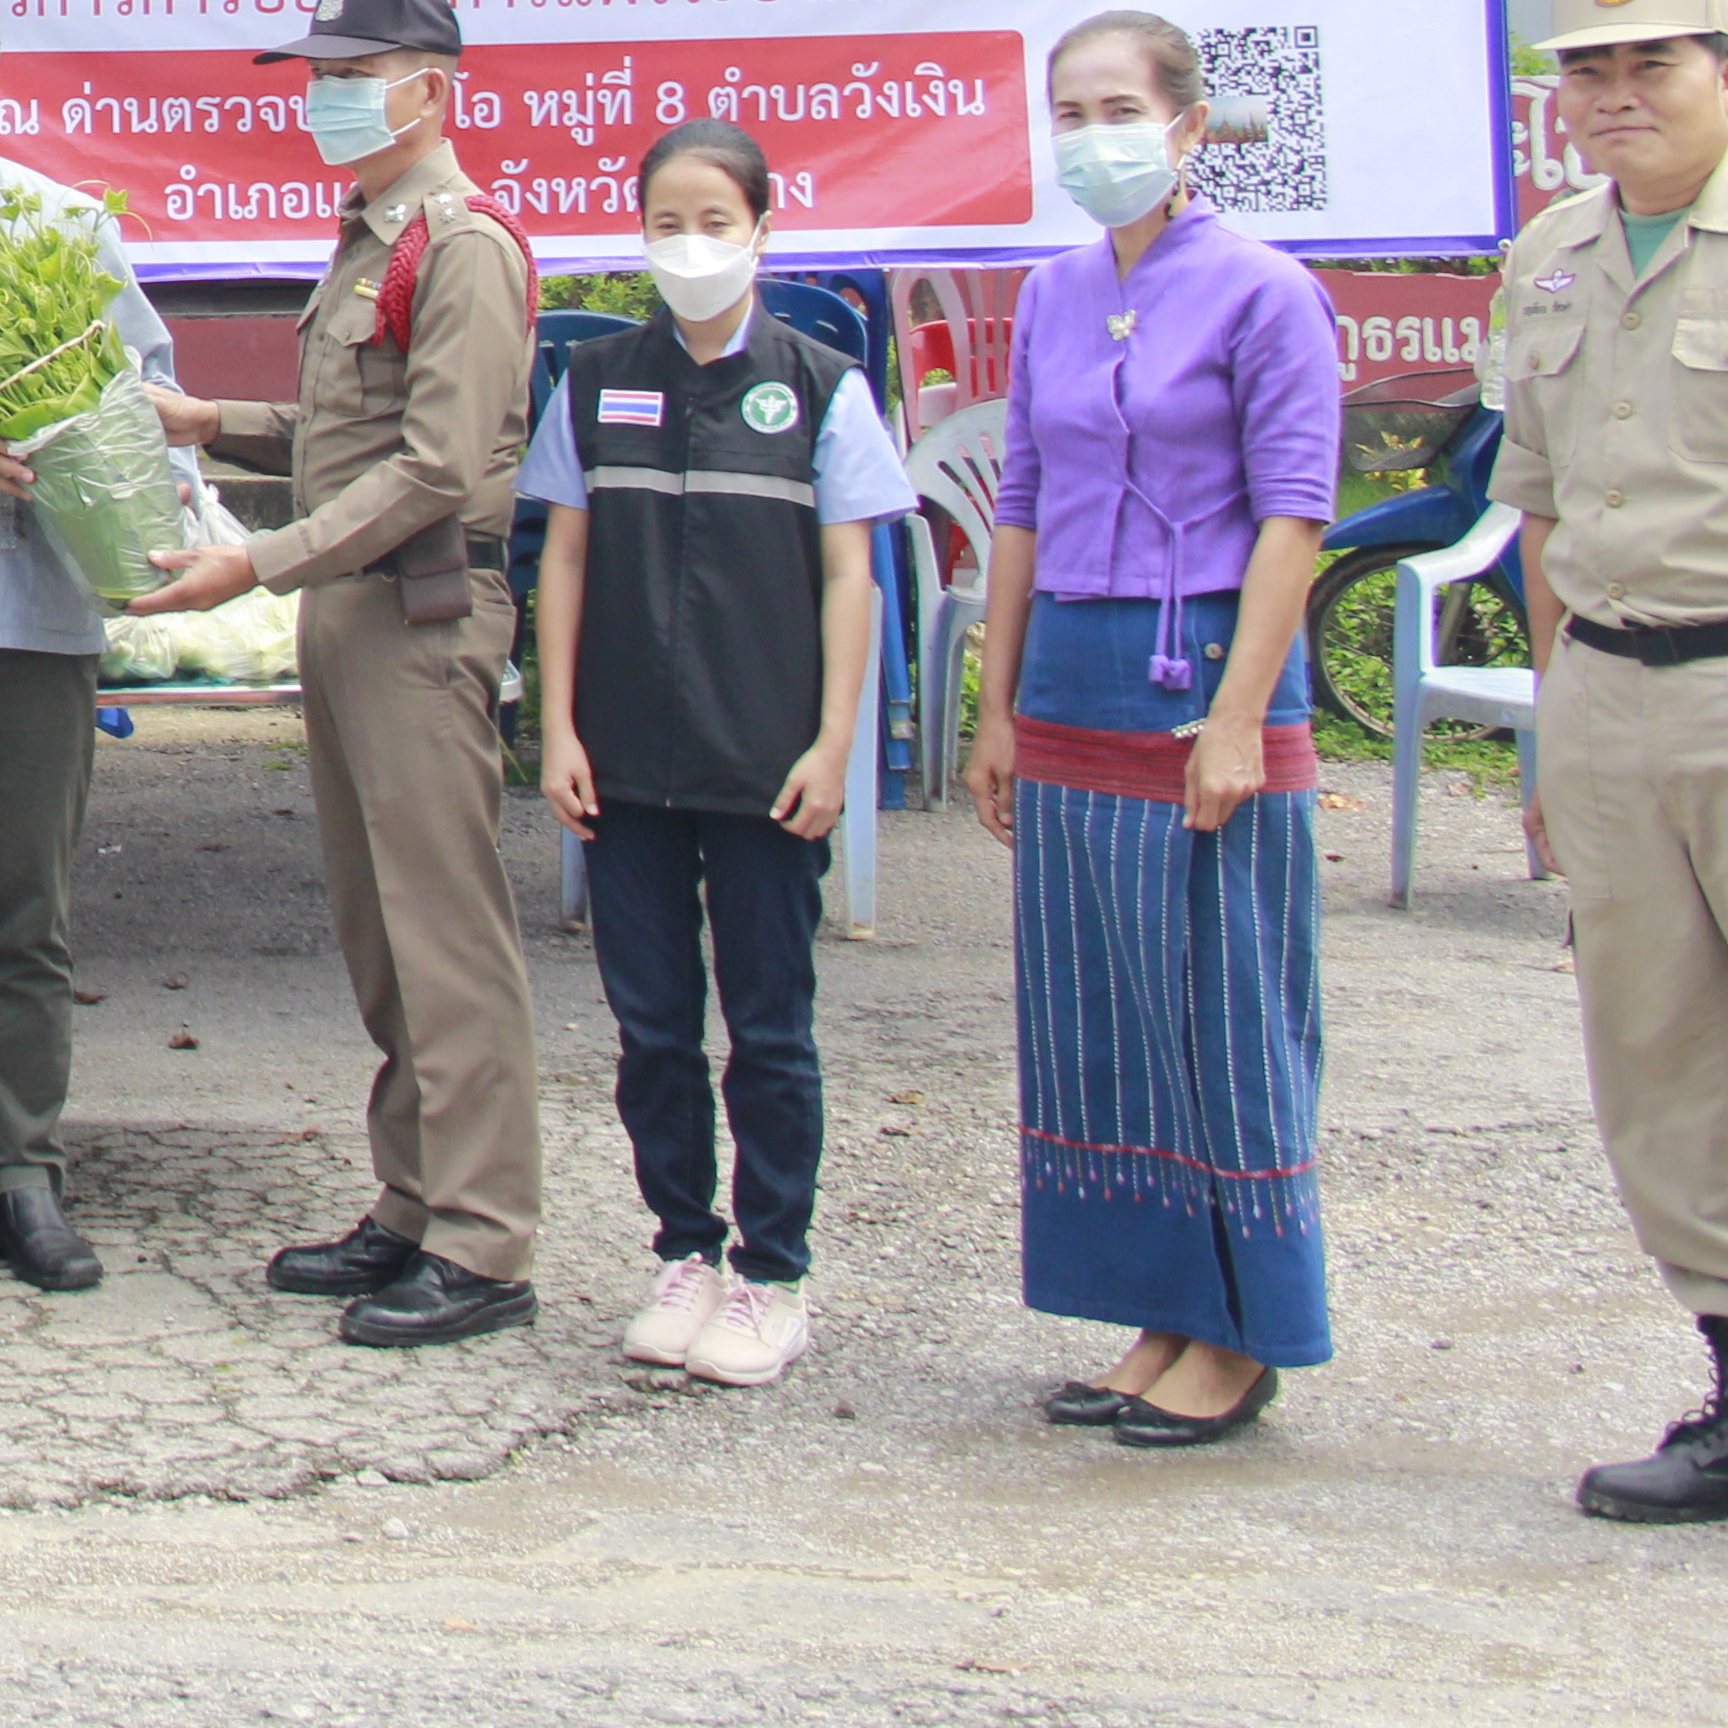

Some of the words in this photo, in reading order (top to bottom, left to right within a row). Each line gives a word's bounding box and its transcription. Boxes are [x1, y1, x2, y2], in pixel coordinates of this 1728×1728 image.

[522, 55, 633, 147] หมู่ที่
[655, 80, 686, 124] 8
[707, 61, 986, 122] ตำบลวังเงิน
